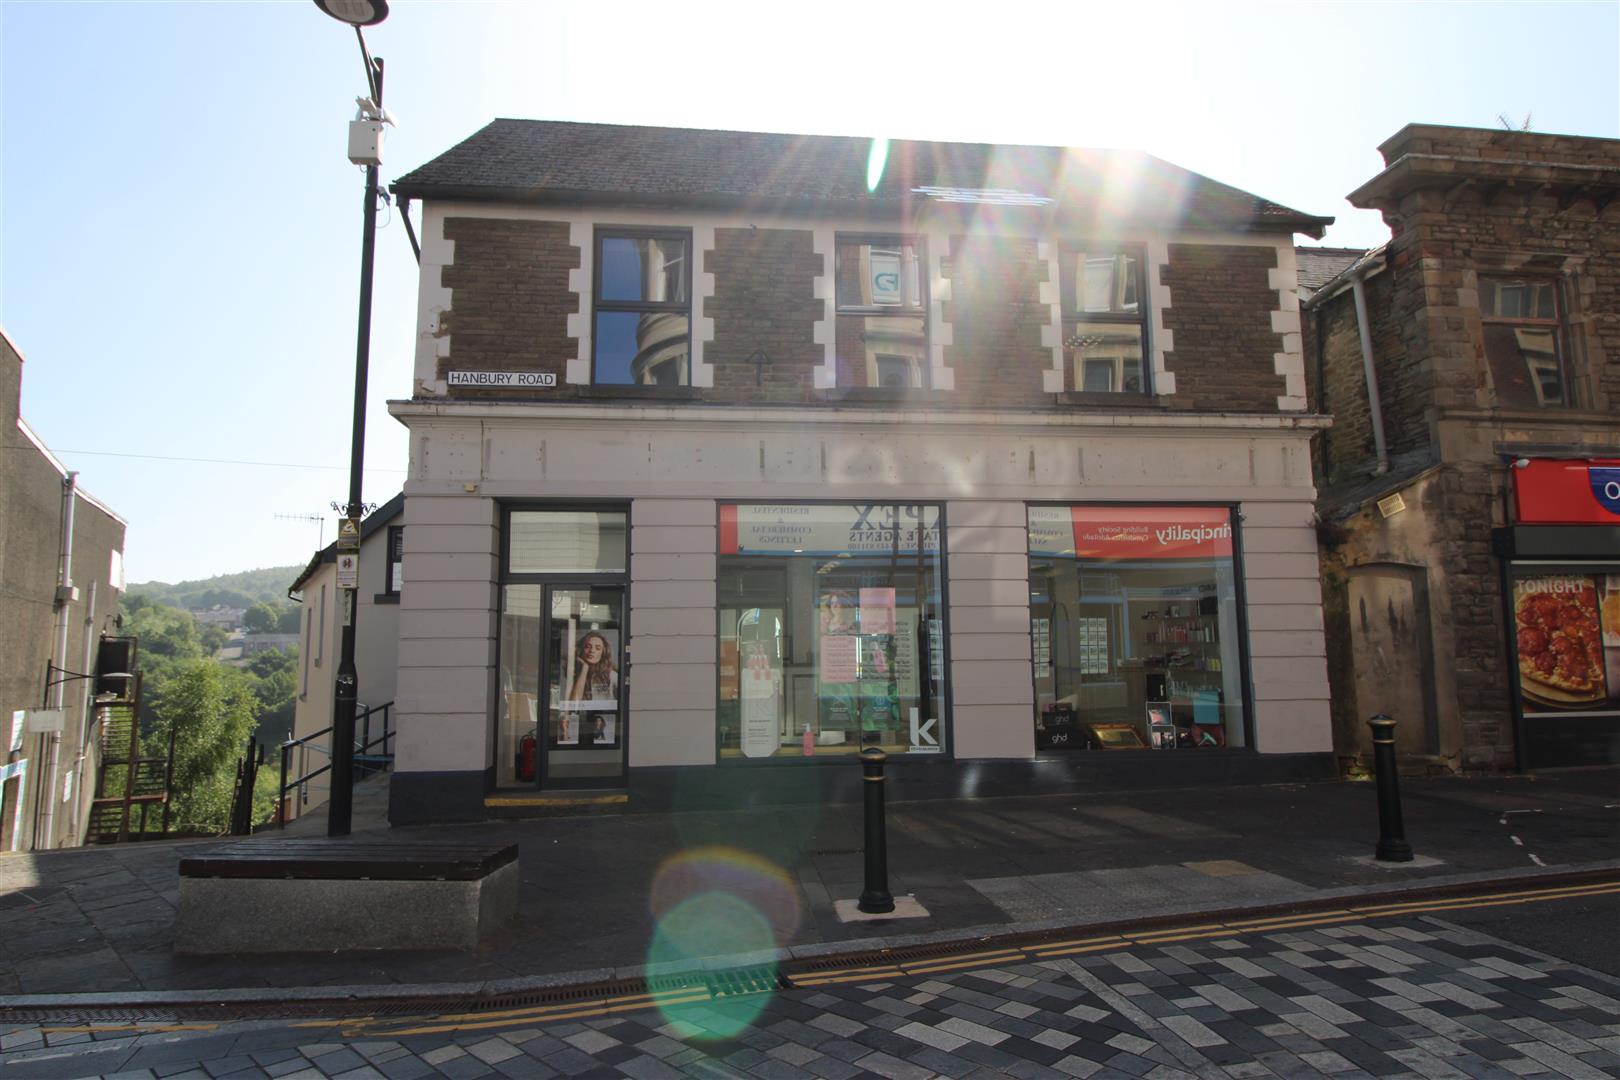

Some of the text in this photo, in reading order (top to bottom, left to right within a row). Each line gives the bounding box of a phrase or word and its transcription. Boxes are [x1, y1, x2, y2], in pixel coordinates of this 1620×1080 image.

[451, 373, 554, 385] HANBURY ROAD
[1515, 579, 1584, 593] TONIGHT
[1051, 733, 1067, 744] ghd
